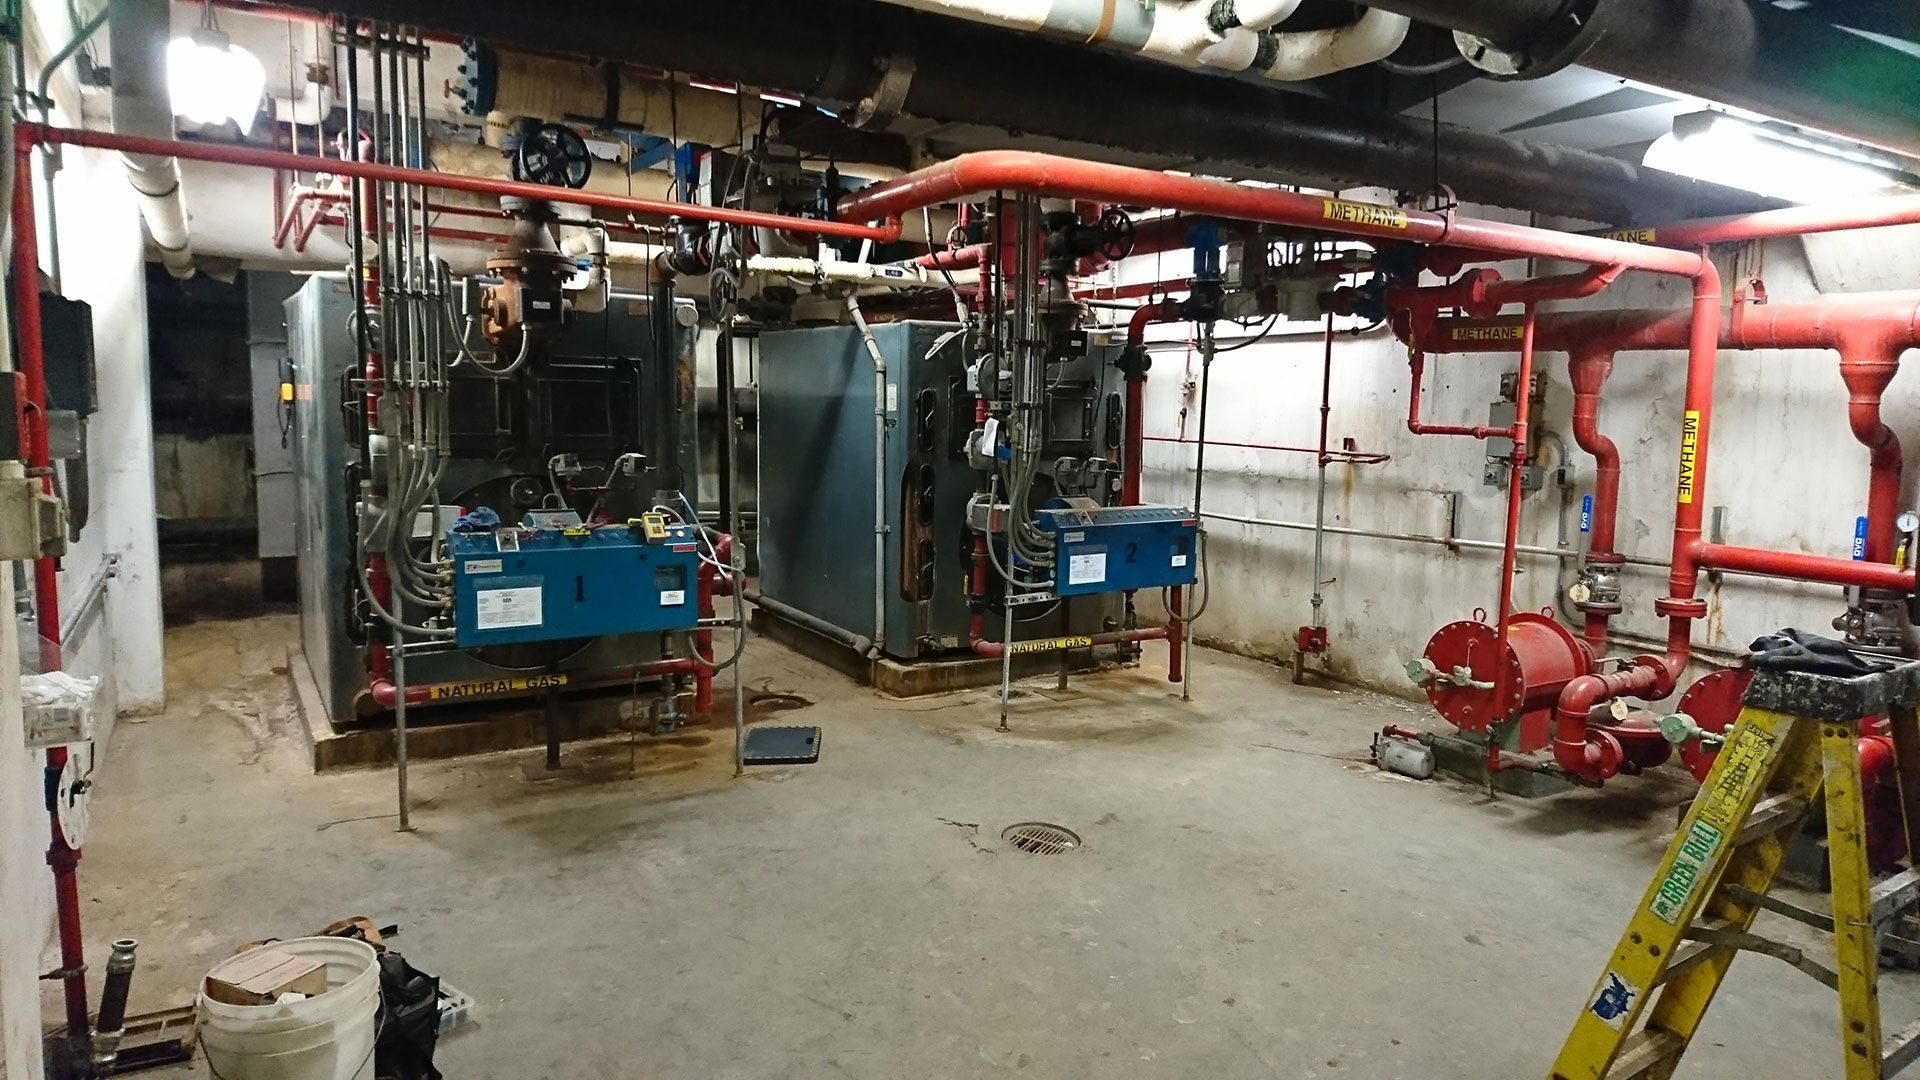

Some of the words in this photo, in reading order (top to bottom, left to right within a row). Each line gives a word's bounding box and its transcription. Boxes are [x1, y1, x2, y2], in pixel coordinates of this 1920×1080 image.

[1330, 202, 1400, 227] METHANE
[1457, 327, 1518, 339] METHANE
[1680, 418, 1697, 496] METHANE
[1125, 542, 1137, 564] 2
[575, 574, 586, 602] 1
[1011, 640, 1060, 653] NATURAL
[1065, 637, 1088, 648] GAS
[438, 679, 518, 699] NATURAL
[526, 675, 561, 689] GAS
[1660, 860, 1698, 905] GREEN
[1682, 823, 1720, 862] BULL
